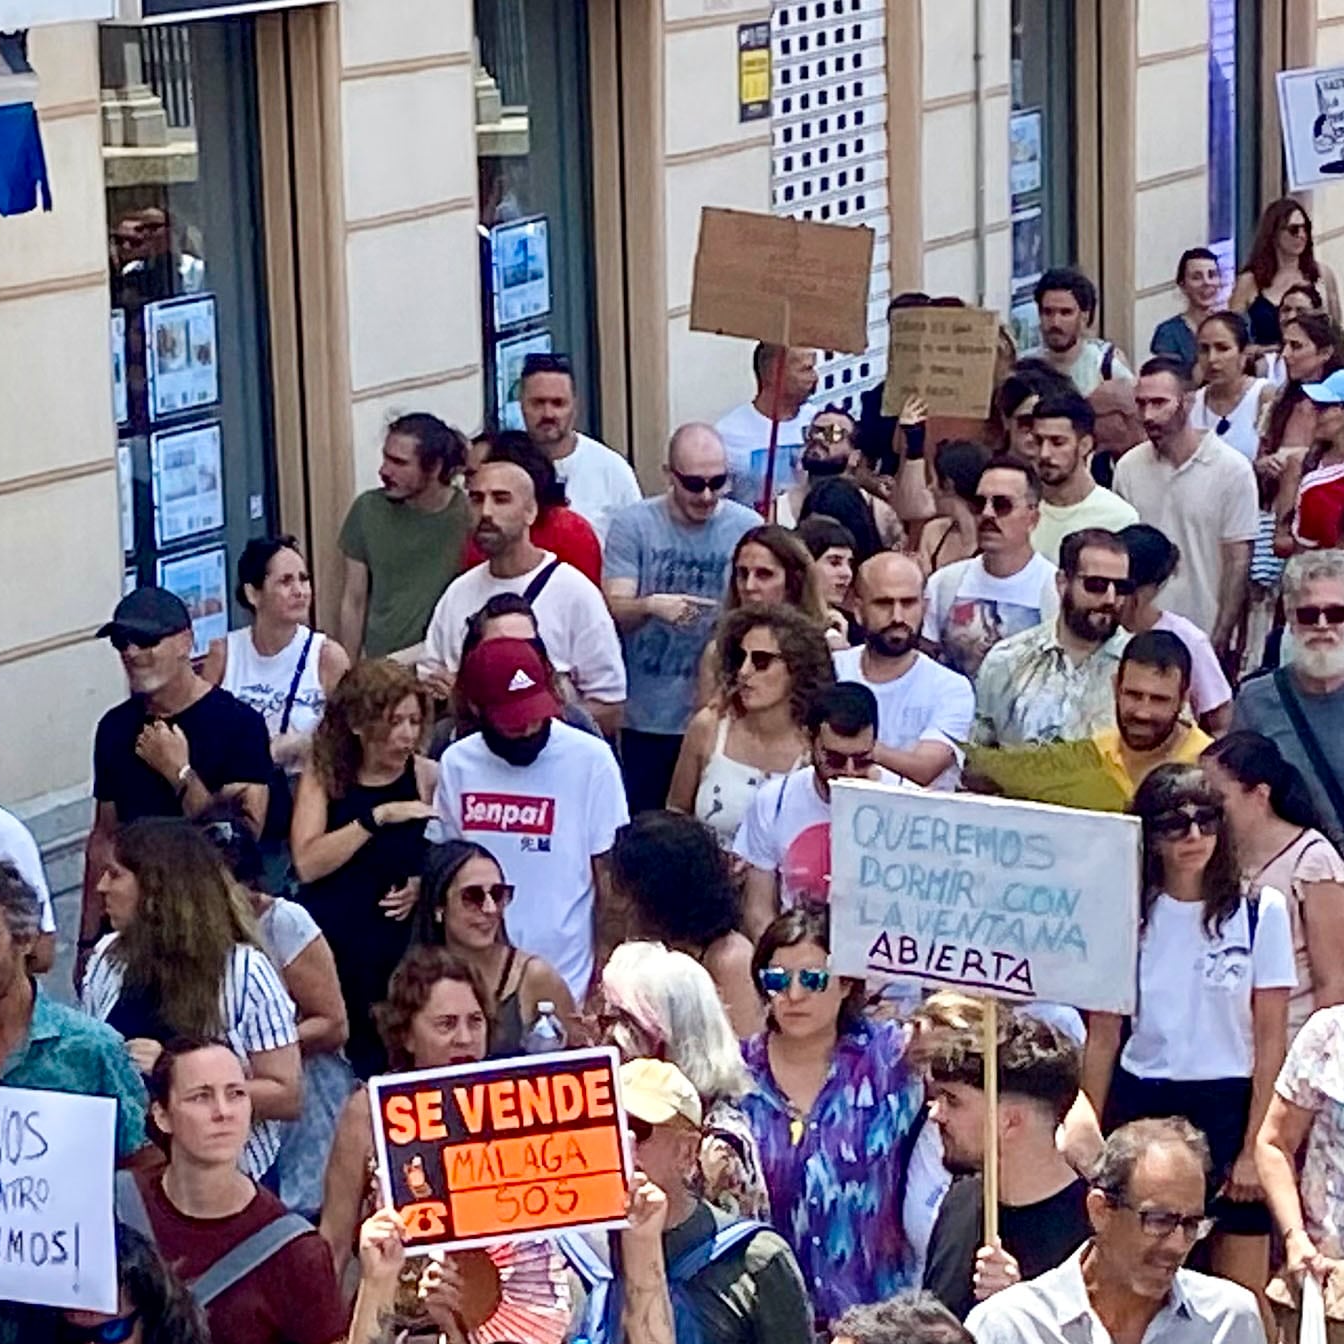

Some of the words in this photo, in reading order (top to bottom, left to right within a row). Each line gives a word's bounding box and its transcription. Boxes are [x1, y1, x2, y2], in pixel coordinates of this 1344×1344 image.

[463, 795, 550, 832] Senpai
[852, 804, 1056, 871] QUEREMOS
[1001, 882, 1082, 918] CON
[858, 900, 905, 928] LA
[916, 909, 1089, 962] VENTANA
[867, 930, 1035, 990] ABIERTA
[385, 1089, 449, 1146] SE
[453, 1068, 615, 1135] VENDE
[494, 1180, 580, 1223] SOS
